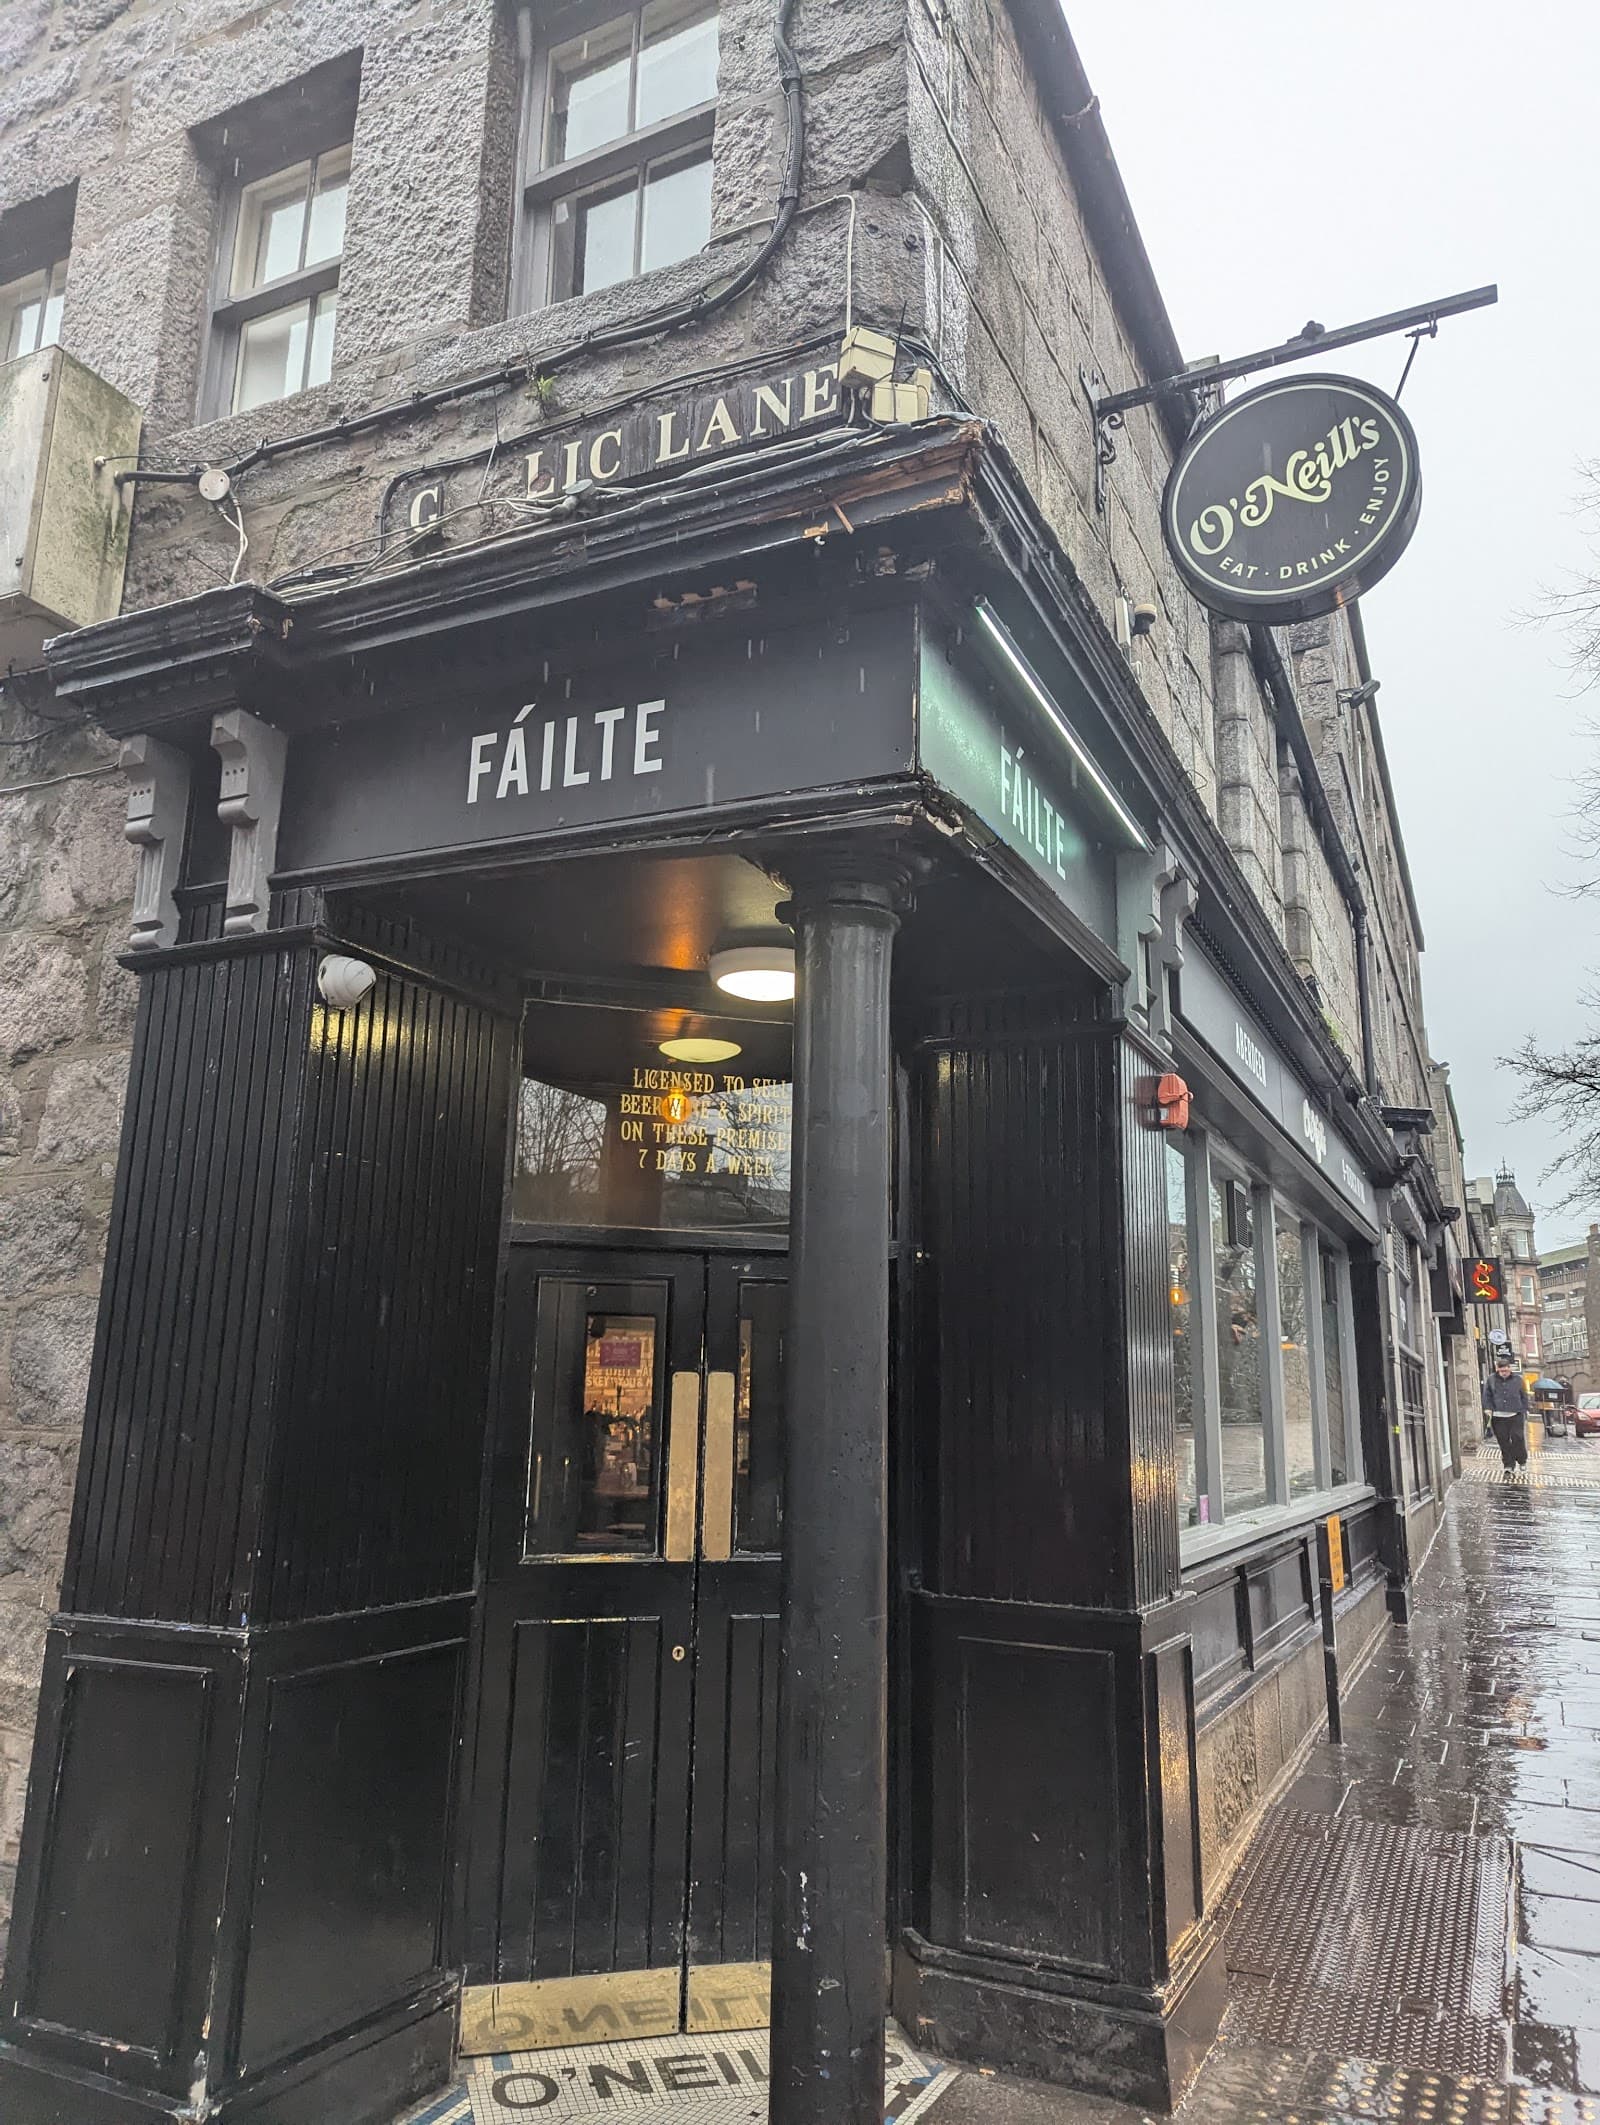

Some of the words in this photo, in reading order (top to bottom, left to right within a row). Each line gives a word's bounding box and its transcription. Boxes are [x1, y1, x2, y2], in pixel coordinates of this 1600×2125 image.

[655, 363, 839, 465] LANE
[1190, 416, 1380, 555] O'Neill's
[1219, 556, 1258, 579] EAT
[1279, 538, 1352, 579] DRINK
[1359, 457, 1390, 526] ENJOY
[467, 699, 665, 804] FÁILTE
[1001, 745, 1066, 880] FÁILTE
[620, 1093, 662, 1116] BEER
[718, 1100, 729, 1120] &
[633, 1068, 715, 1093] LICENSED
[723, 1075, 745, 1095] TO
[752, 1077, 789, 1098] SELL
[621, 1120, 644, 1141] ON
[653, 1122, 708, 1146] THESE
[715, 1127, 791, 1151] PREMISE
[638, 1148, 648, 1169] 7
[656, 1150, 696, 1172] DAYS
[705, 1153, 716, 1174] A
[728, 1155, 775, 1177] WEEK
[492, 2050, 904, 2109] O'NEIL
